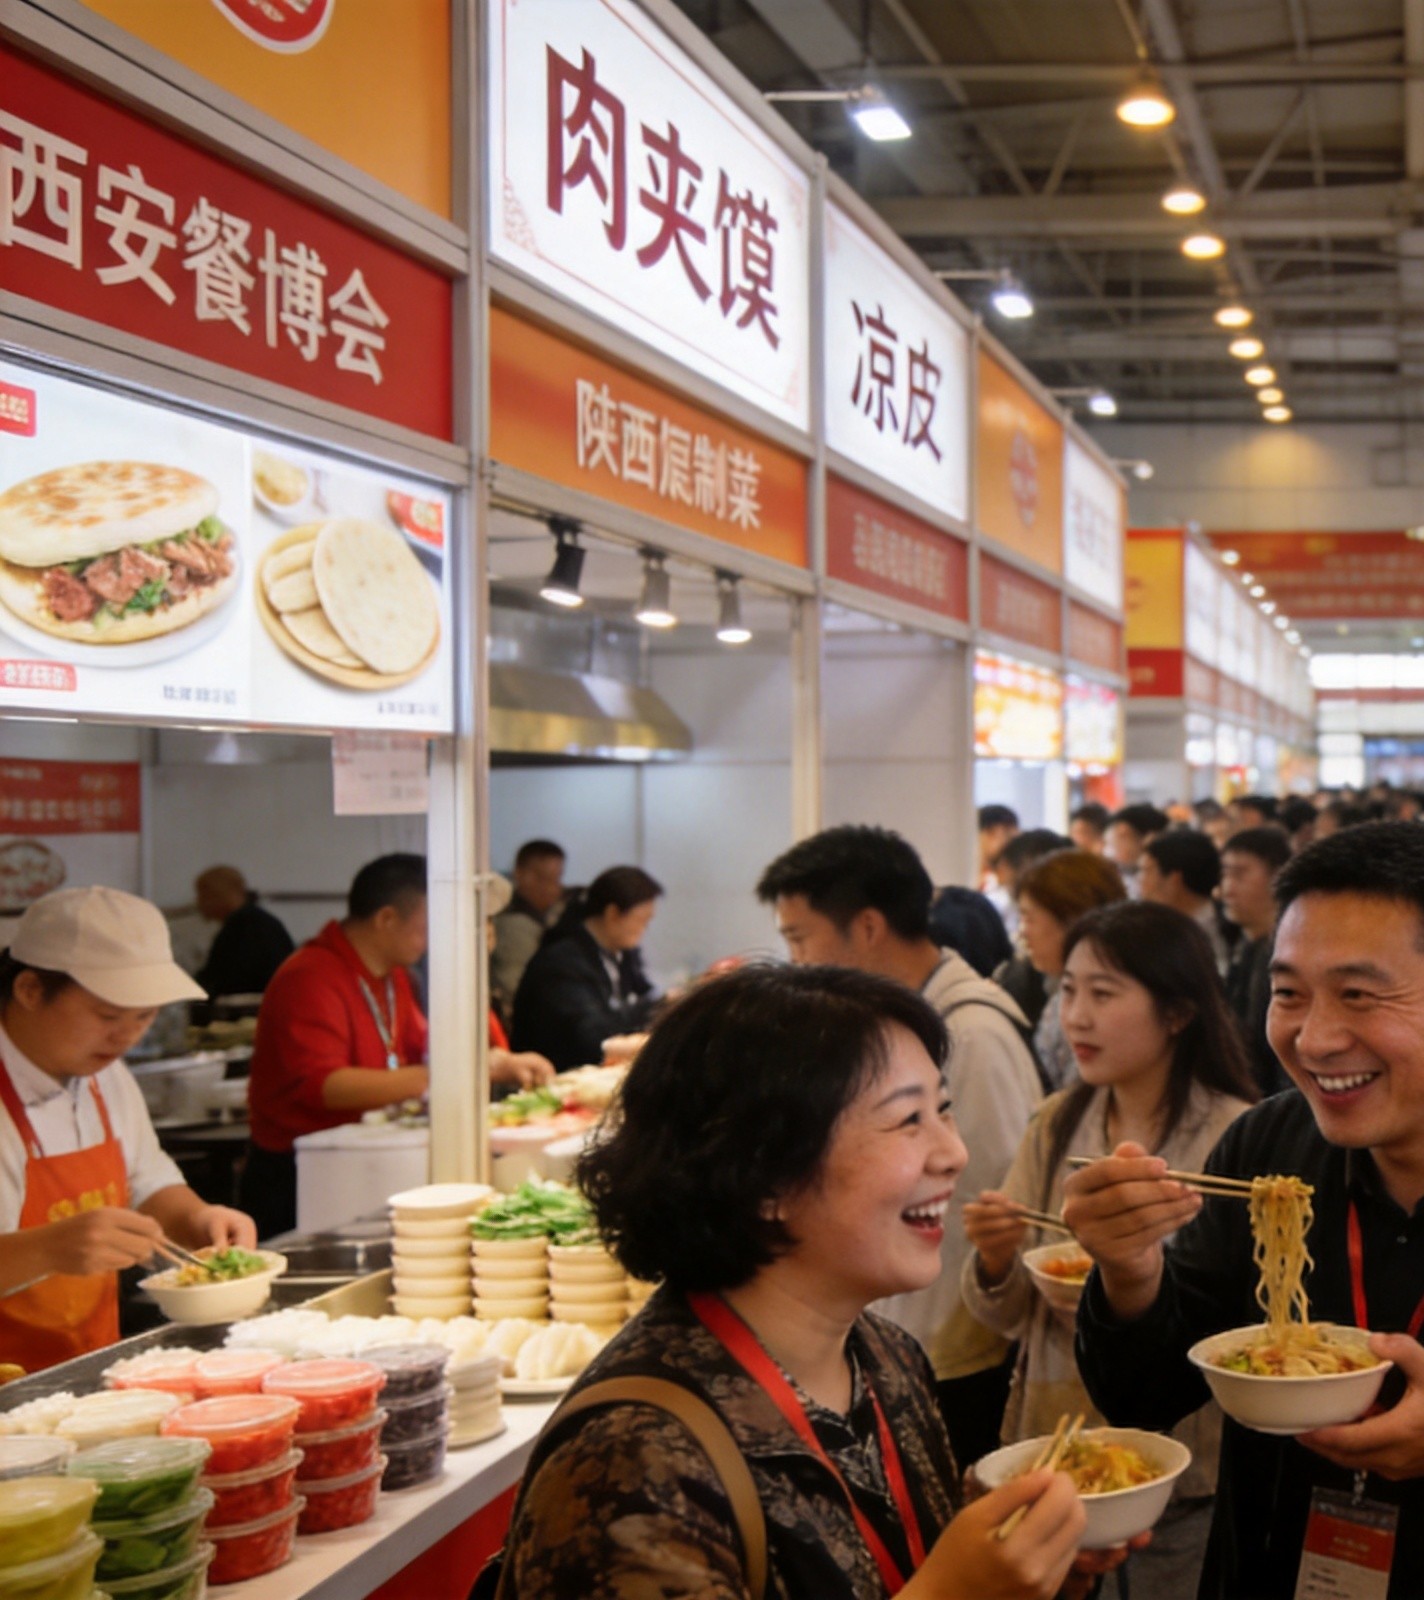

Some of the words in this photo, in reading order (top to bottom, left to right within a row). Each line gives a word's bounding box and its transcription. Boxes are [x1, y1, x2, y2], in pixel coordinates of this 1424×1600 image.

[0, 108, 390, 385] 西安餐博会
[546, 42, 781, 351] 肉夹馍
[851, 300, 942, 463] 凉皮
